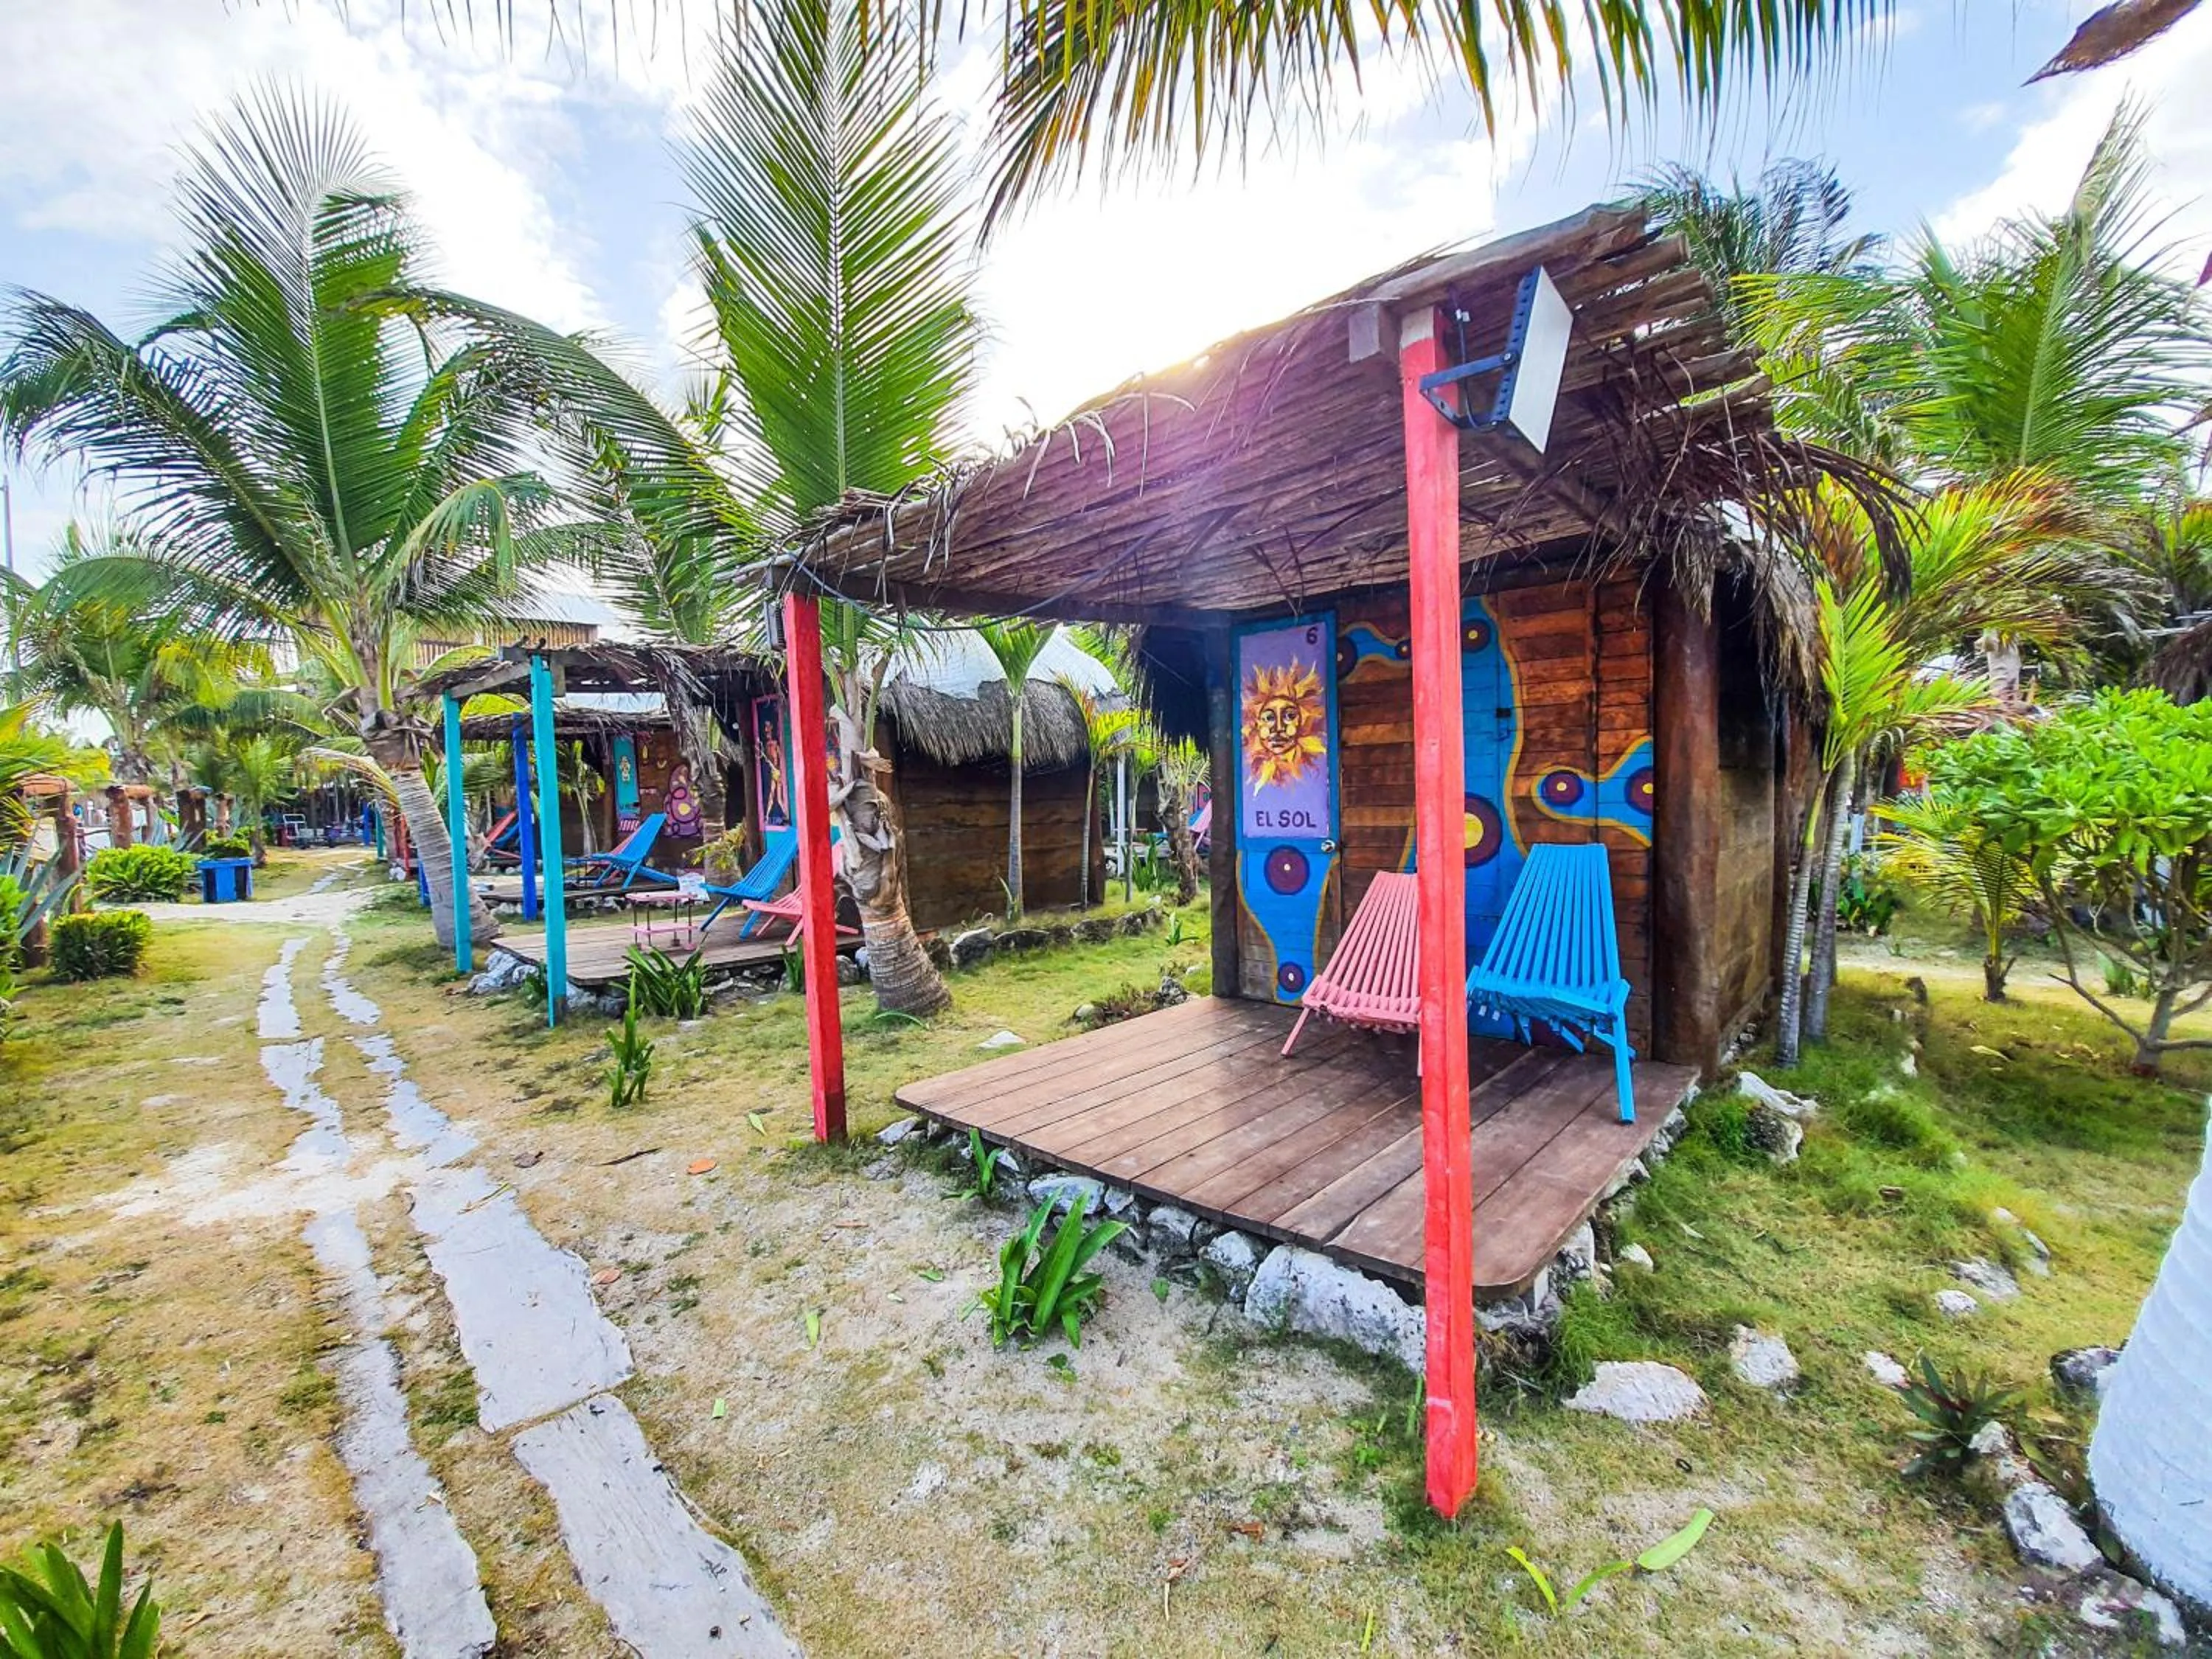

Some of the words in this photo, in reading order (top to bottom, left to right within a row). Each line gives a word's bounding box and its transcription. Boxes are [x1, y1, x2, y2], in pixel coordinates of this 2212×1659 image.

[1306, 626, 1318, 645] 6
[1256, 810, 1273, 827] EL
[1278, 810, 1317, 828] SOL
